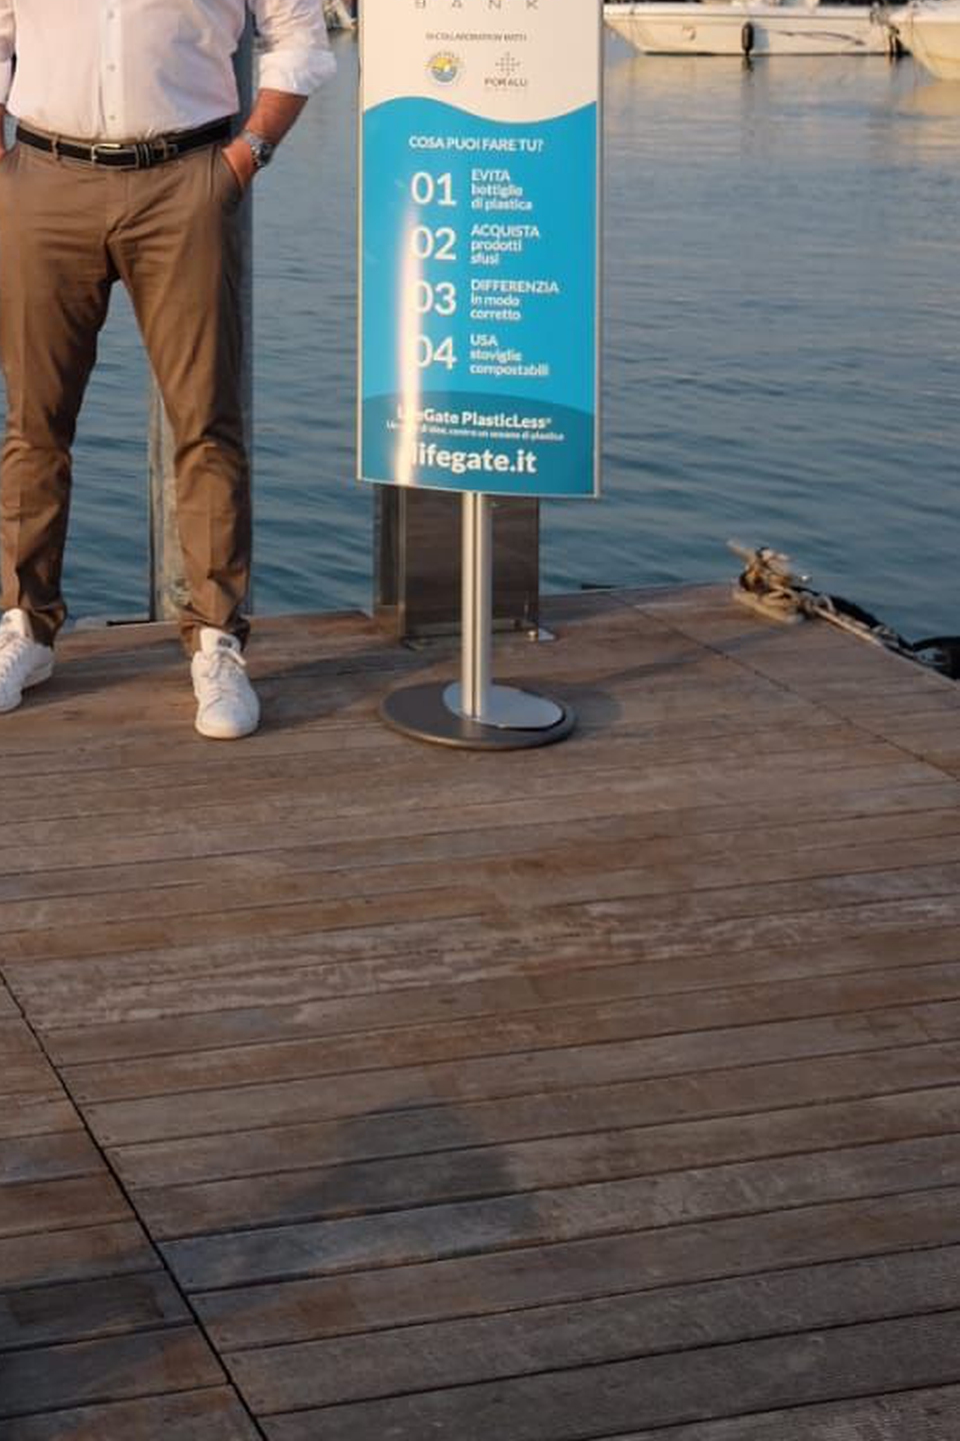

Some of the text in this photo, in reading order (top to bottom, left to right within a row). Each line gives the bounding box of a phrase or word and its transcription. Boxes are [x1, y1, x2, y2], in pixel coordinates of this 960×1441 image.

[408, 135, 544, 152] COSA PUOI FARE TU?
[470, 168, 511, 182] EVITA
[410, 171, 458, 207] 01
[470, 198, 533, 212] di plastica
[470, 224, 540, 239] ACQUISTA
[410, 226, 458, 261] 02
[470, 239, 522, 254] prodotti
[470, 253, 500, 265] sfusi
[470, 279, 560, 294] DIFFERENZIA
[410, 280, 458, 315] 03
[470, 292, 520, 306] in modo
[470, 308, 522, 321] corretto
[469, 333, 499, 347] USA
[411, 334, 458, 371] 04
[469, 349, 523, 363] stoviglie
[469, 363, 550, 378] compostabili
[411, 443, 538, 473] lifegate.it
